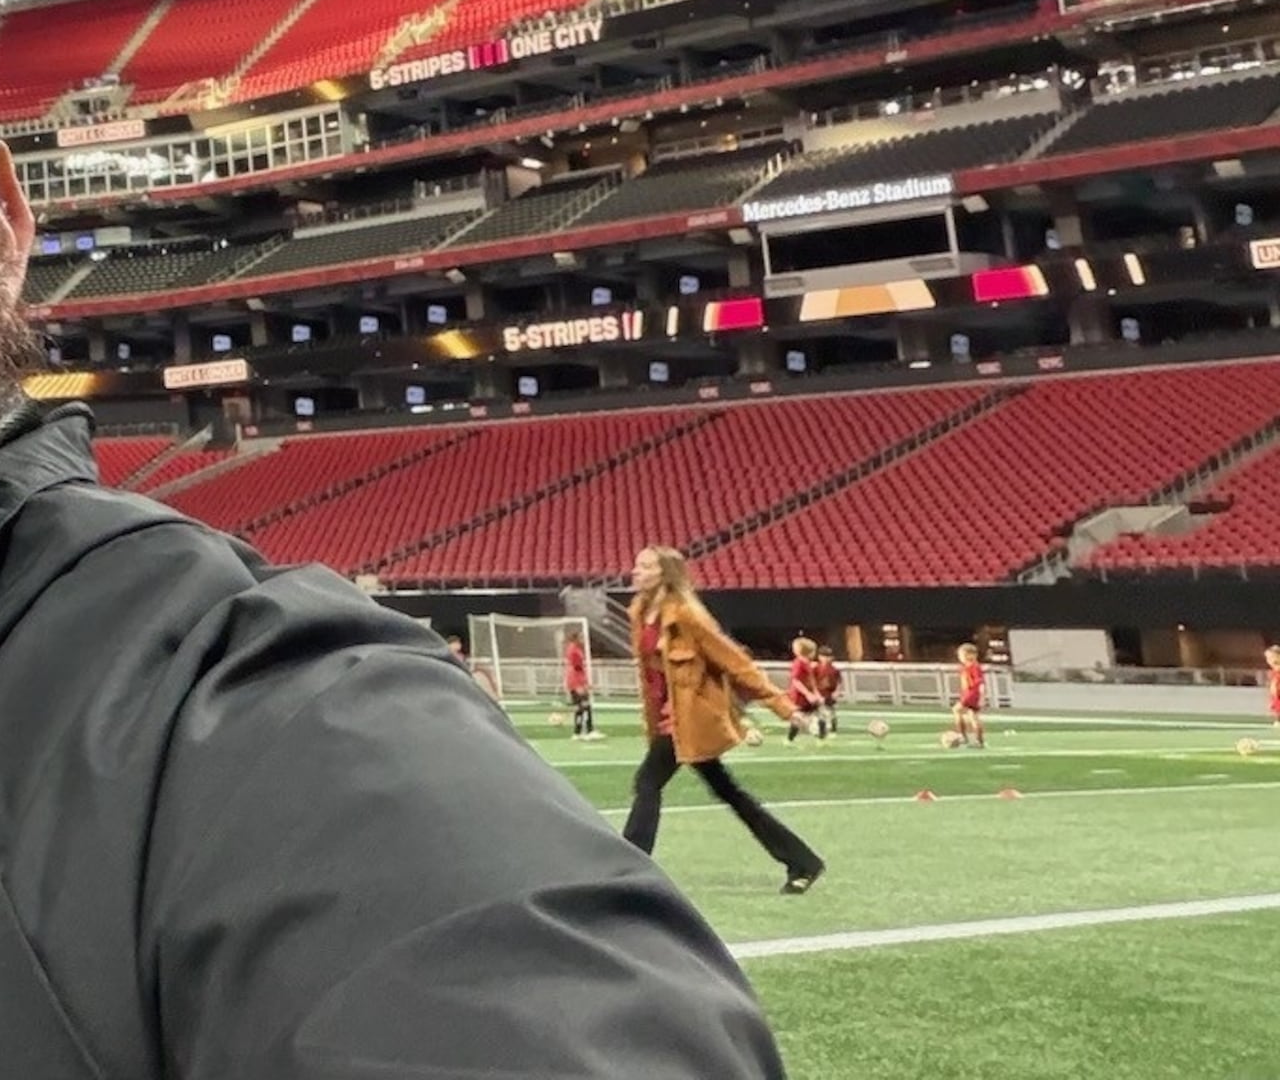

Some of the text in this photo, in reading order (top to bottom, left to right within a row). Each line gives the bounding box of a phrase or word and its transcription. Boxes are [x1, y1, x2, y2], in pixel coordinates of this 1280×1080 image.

[511, 30, 552, 59] ONE
[554, 20, 603, 48] CITY
[743, 189, 870, 222] Mercedes-Benz
[873, 175, 951, 204] Stadium
